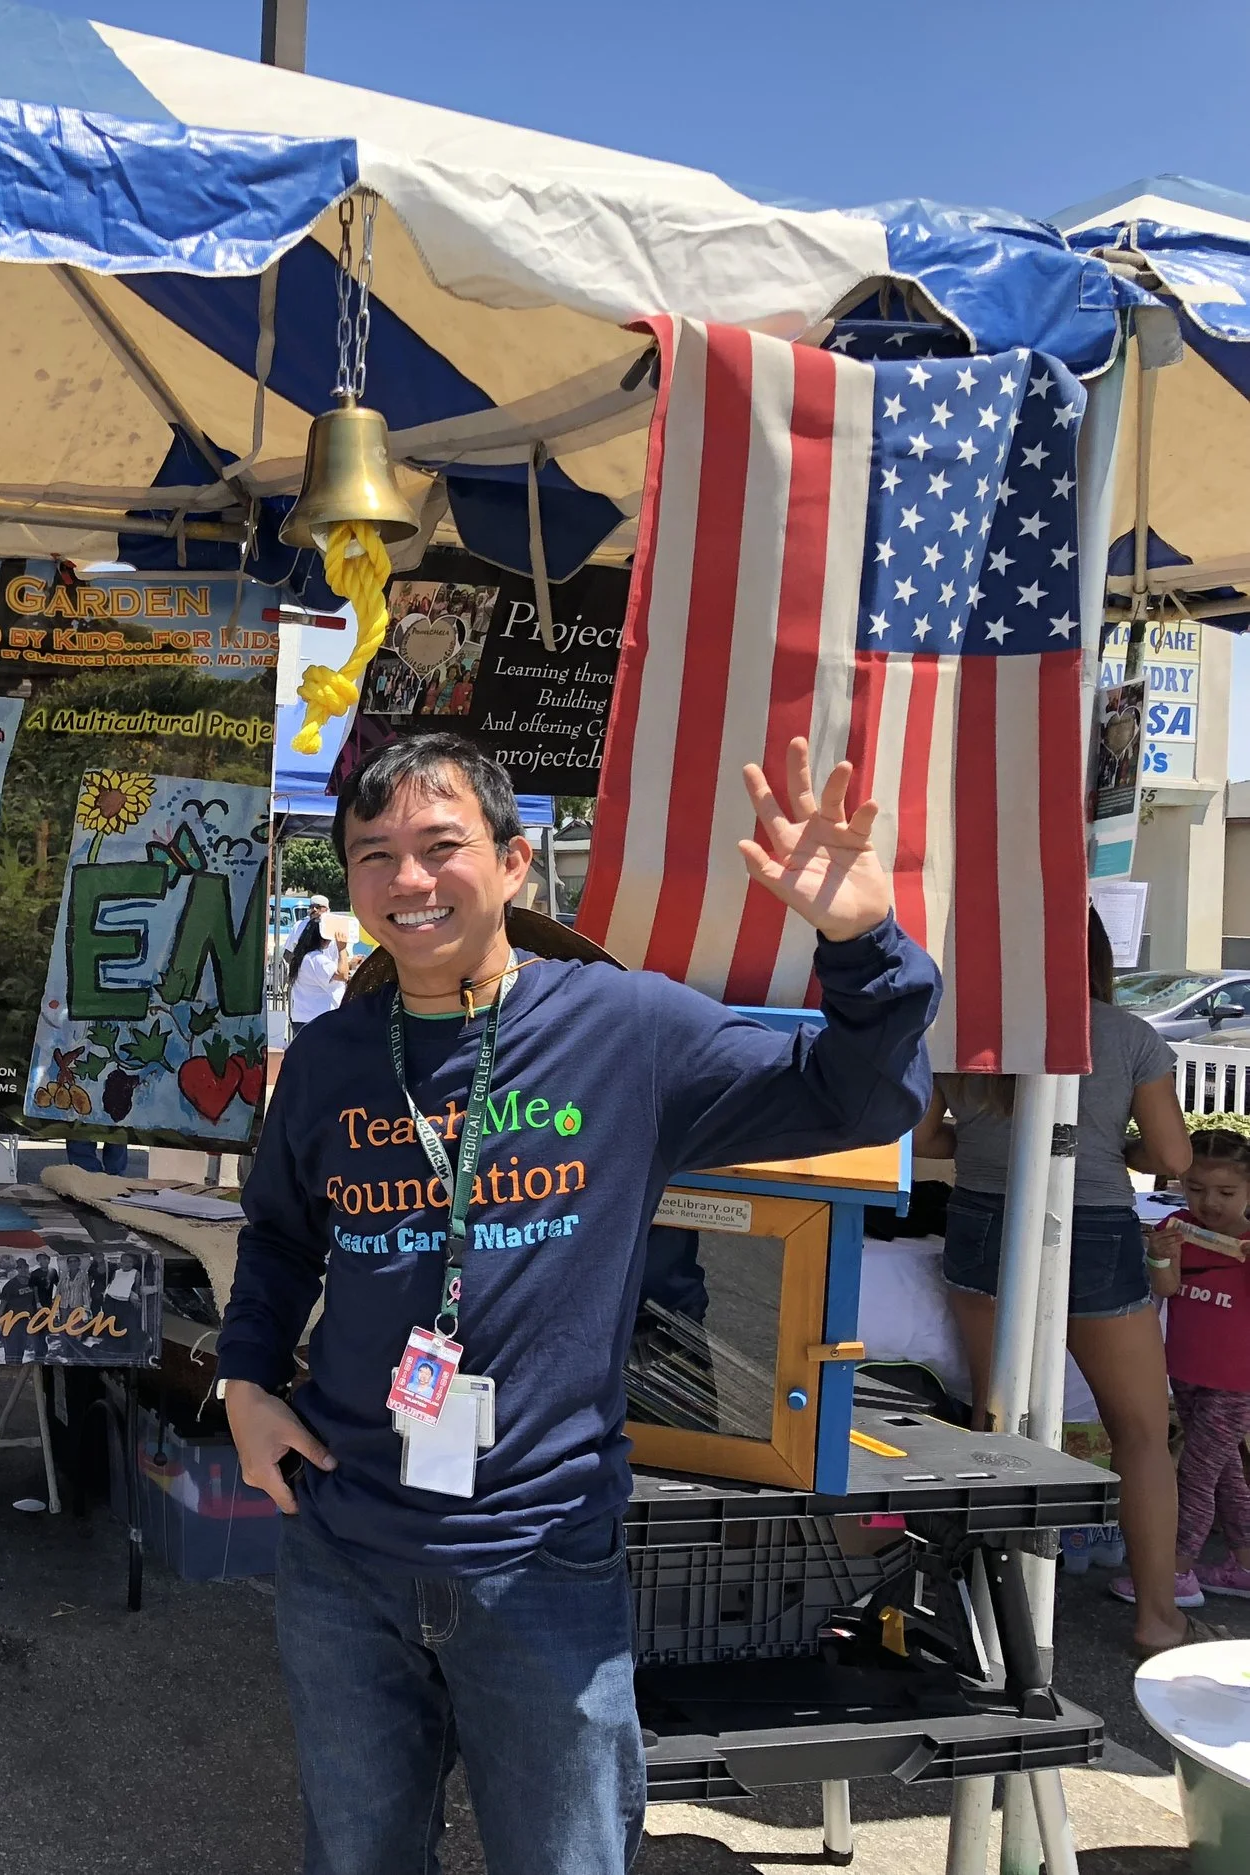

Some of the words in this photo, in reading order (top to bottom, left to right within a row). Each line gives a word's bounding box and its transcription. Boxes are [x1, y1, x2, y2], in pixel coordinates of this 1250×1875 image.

[6, 575, 211, 619] GARDEN
[9, 628, 47, 648] BY
[1, 649, 21, 660] BY
[23, 650, 105, 666] CLARENCE
[108, 653, 213, 667] MONTECLARO,
[217, 653, 246, 667] MD,
[494, 656, 570, 684] Learning
[537, 689, 607, 715] Building
[28, 710, 44, 728] A
[54, 710, 201, 734] Multicultural
[209, 713, 276, 745] Proje
[480, 711, 517, 731] And
[519, 712, 583, 739] offering
[339, 1101, 467, 1149] Teach
[483, 1090, 550, 1135] Me
[462, 1112, 481, 1172] MEDICAL
[473, 1042, 493, 1101] COLLEGE
[680, 1211, 707, 1220] Return
[715, 1214, 735, 1222] Book
[334, 1225, 388, 1254] Learn
[473, 1215, 579, 1250] Matter
[1190, 1286, 1211, 1302] DO
